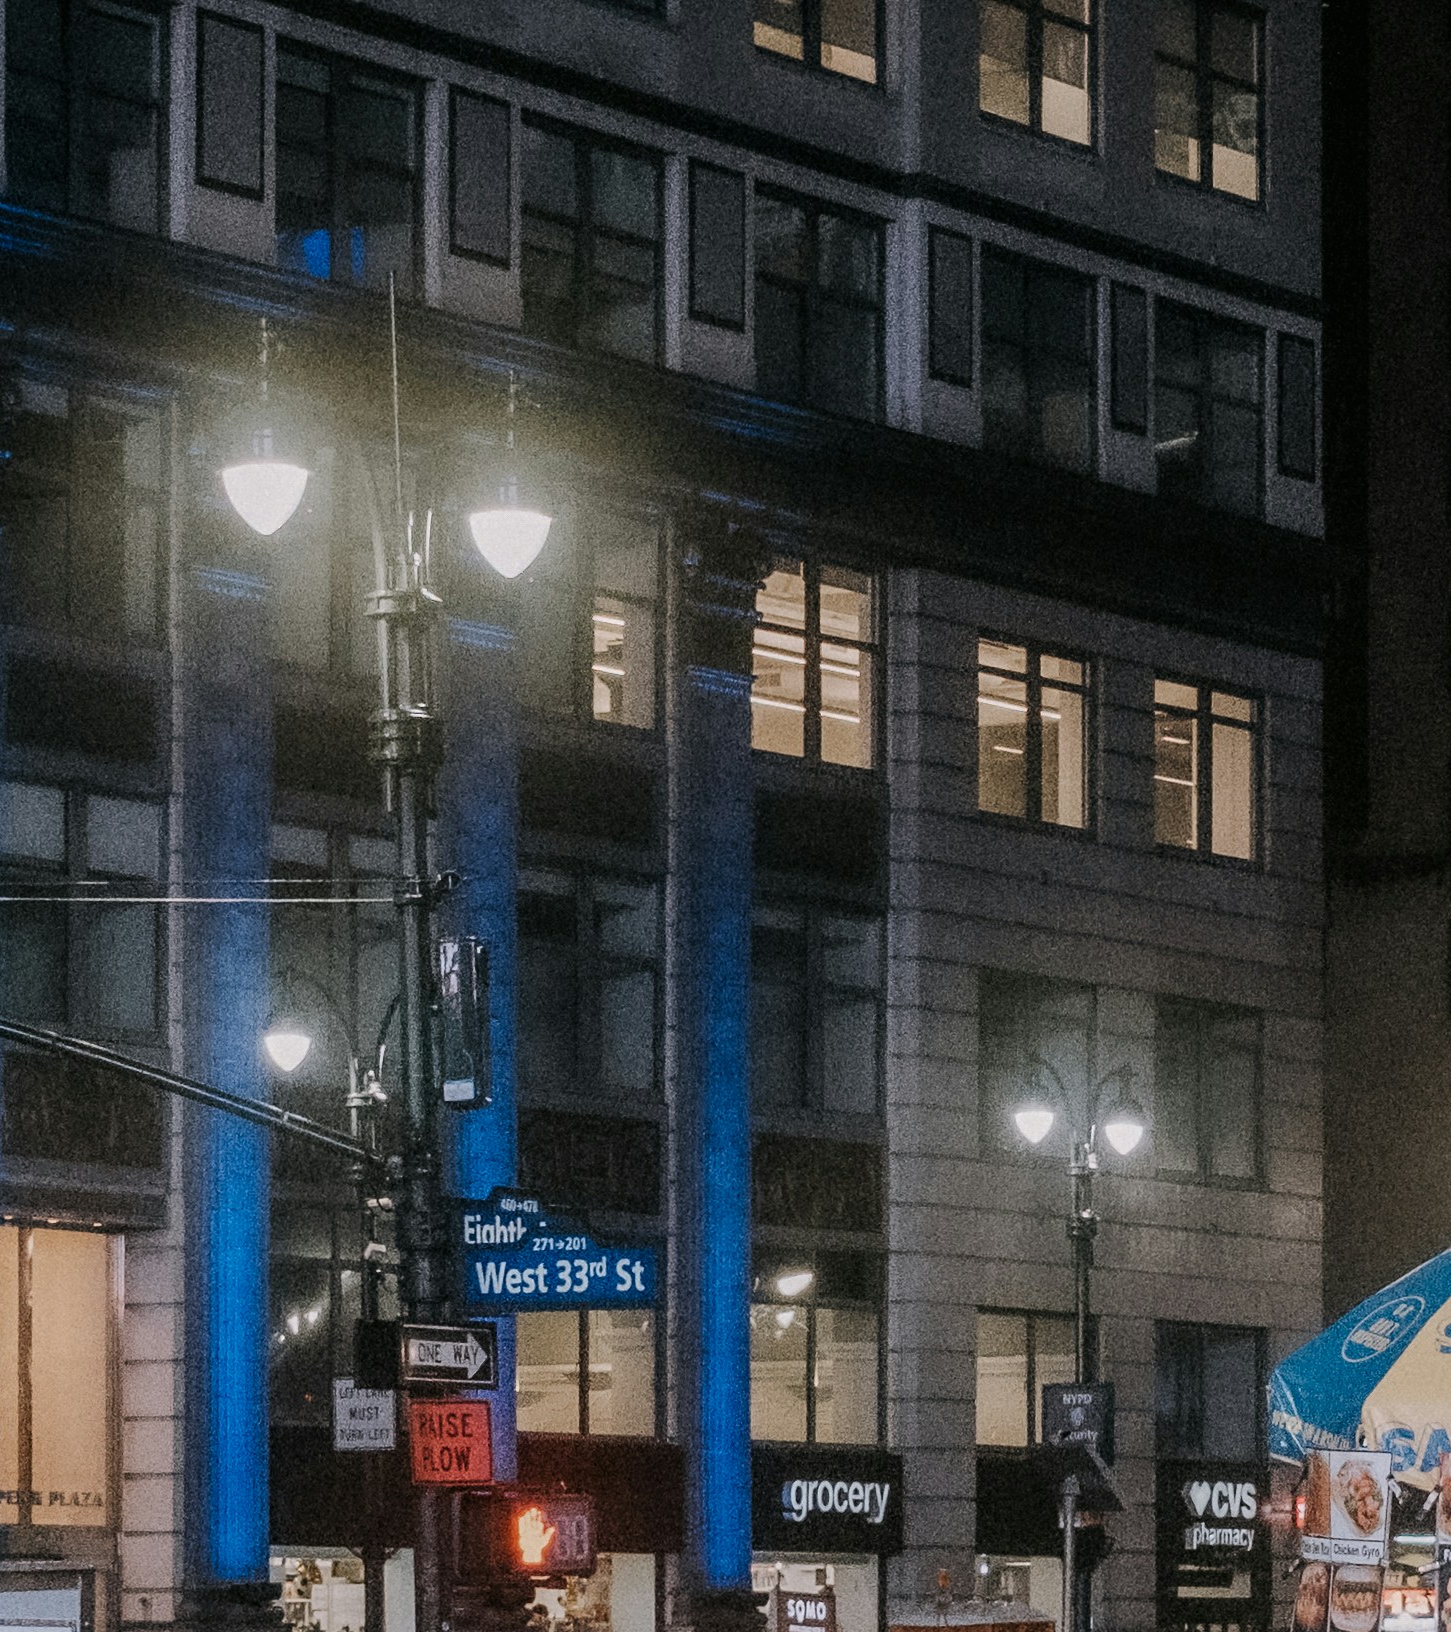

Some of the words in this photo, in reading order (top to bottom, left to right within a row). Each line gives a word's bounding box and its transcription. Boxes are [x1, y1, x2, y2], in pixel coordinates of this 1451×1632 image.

[532, 1236, 554, 1251] 271
[565, 1236, 587, 1250] 201
[475, 1260, 549, 1295] West
[555, 1255, 607, 1294] 33rd
[615, 1258, 646, 1292] St
[417, 1343, 442, 1364] ONE
[452, 1345, 480, 1365] WAY
[1061, 1393, 1093, 1405] NYPD
[348, 1406, 379, 1421] MUST
[367, 1428, 390, 1442] LEFT
[422, 1446, 471, 1473] PLOW
[48, 1490, 104, 1508] PLAZA
[788, 1478, 891, 1524] grocery
[1211, 1480, 1258, 1520] CVS
[1190, 1522, 1255, 1552] pharmacy
[1362, 1545, 1381, 1558] Gyro
